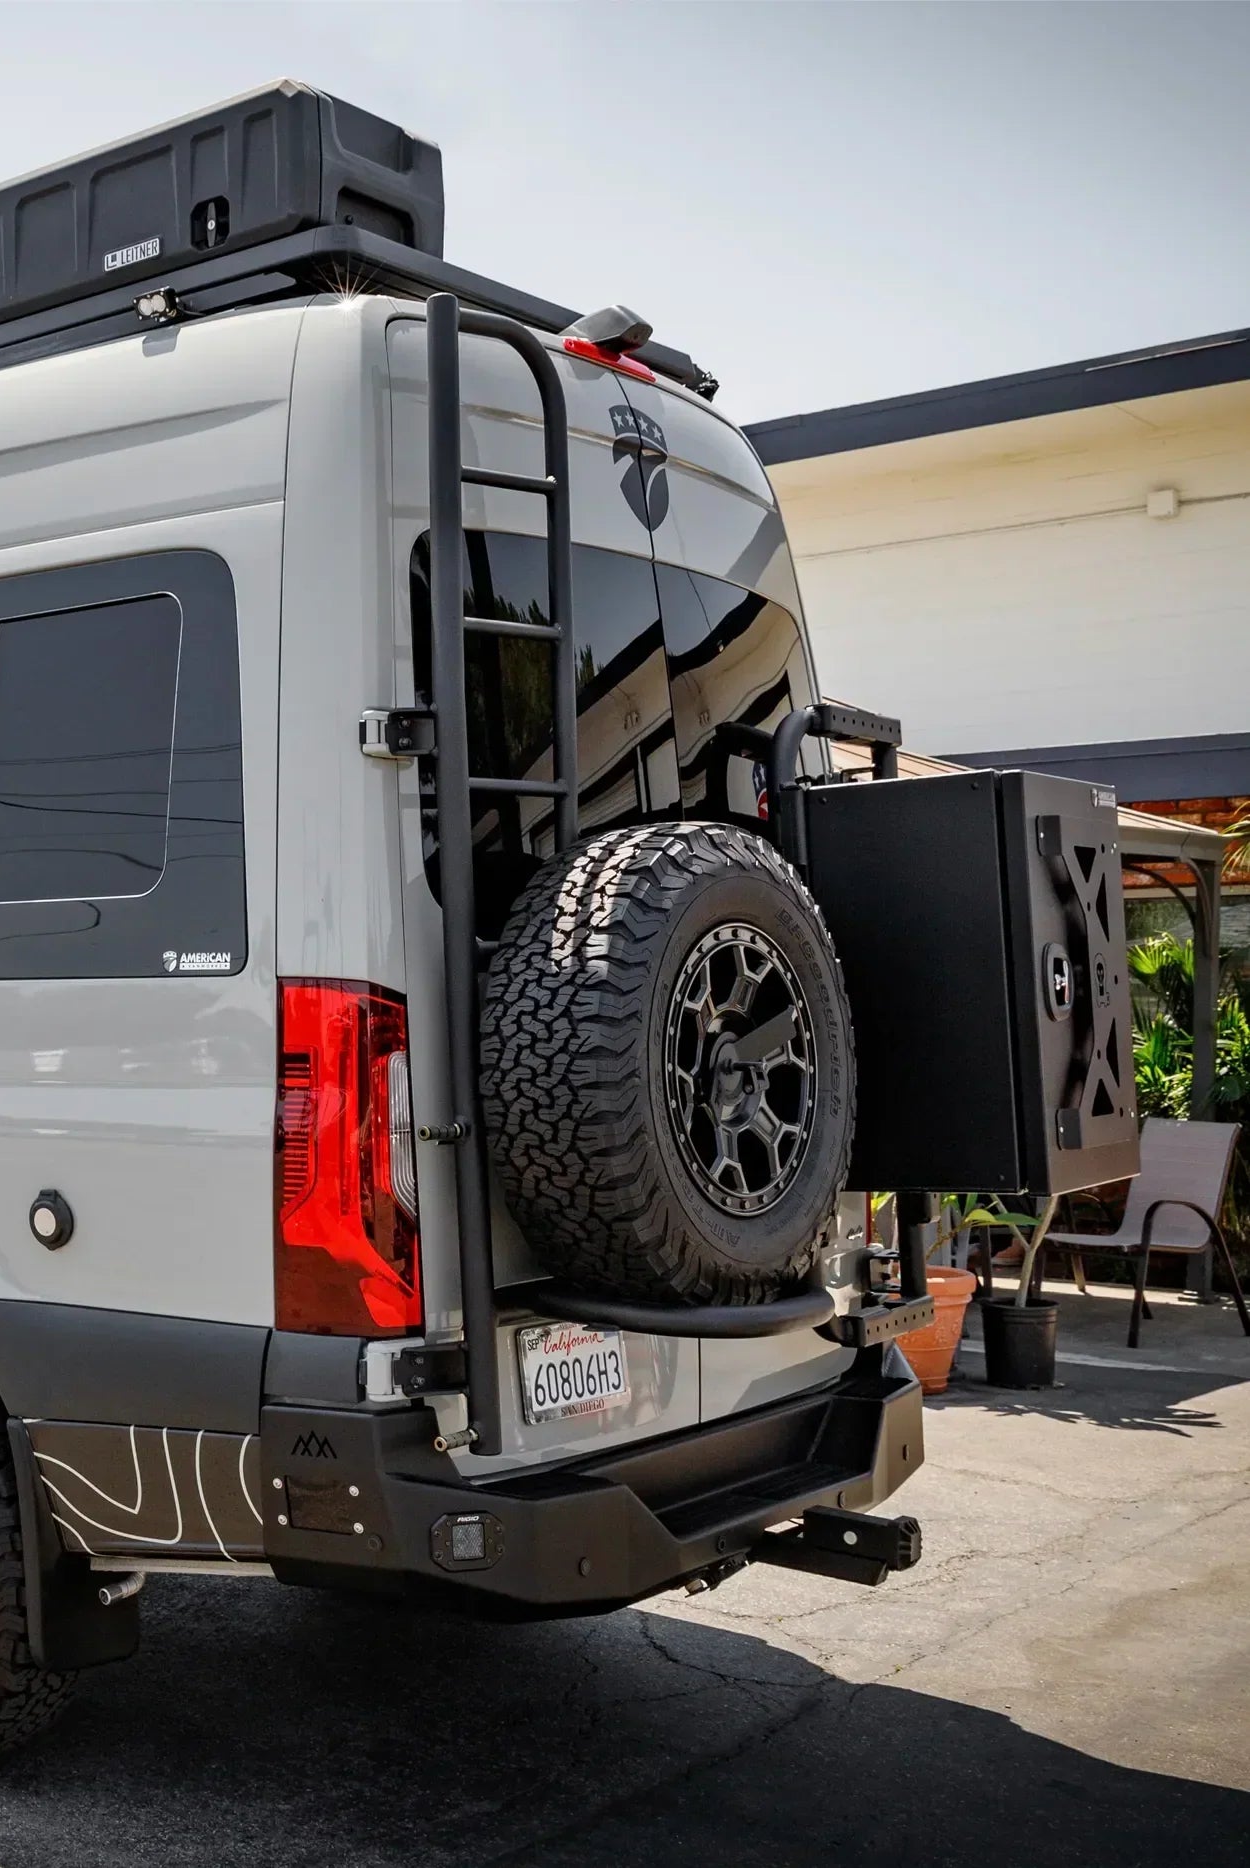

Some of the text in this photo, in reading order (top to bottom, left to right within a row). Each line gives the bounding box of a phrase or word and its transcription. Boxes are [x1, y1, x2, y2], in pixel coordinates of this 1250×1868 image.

[120, 240, 158, 265] LEITNER
[527, 1329, 604, 1356] SEP California
[534, 1350, 621, 1406] 60806H3
[560, 1399, 605, 1417] SAN DIEGO
